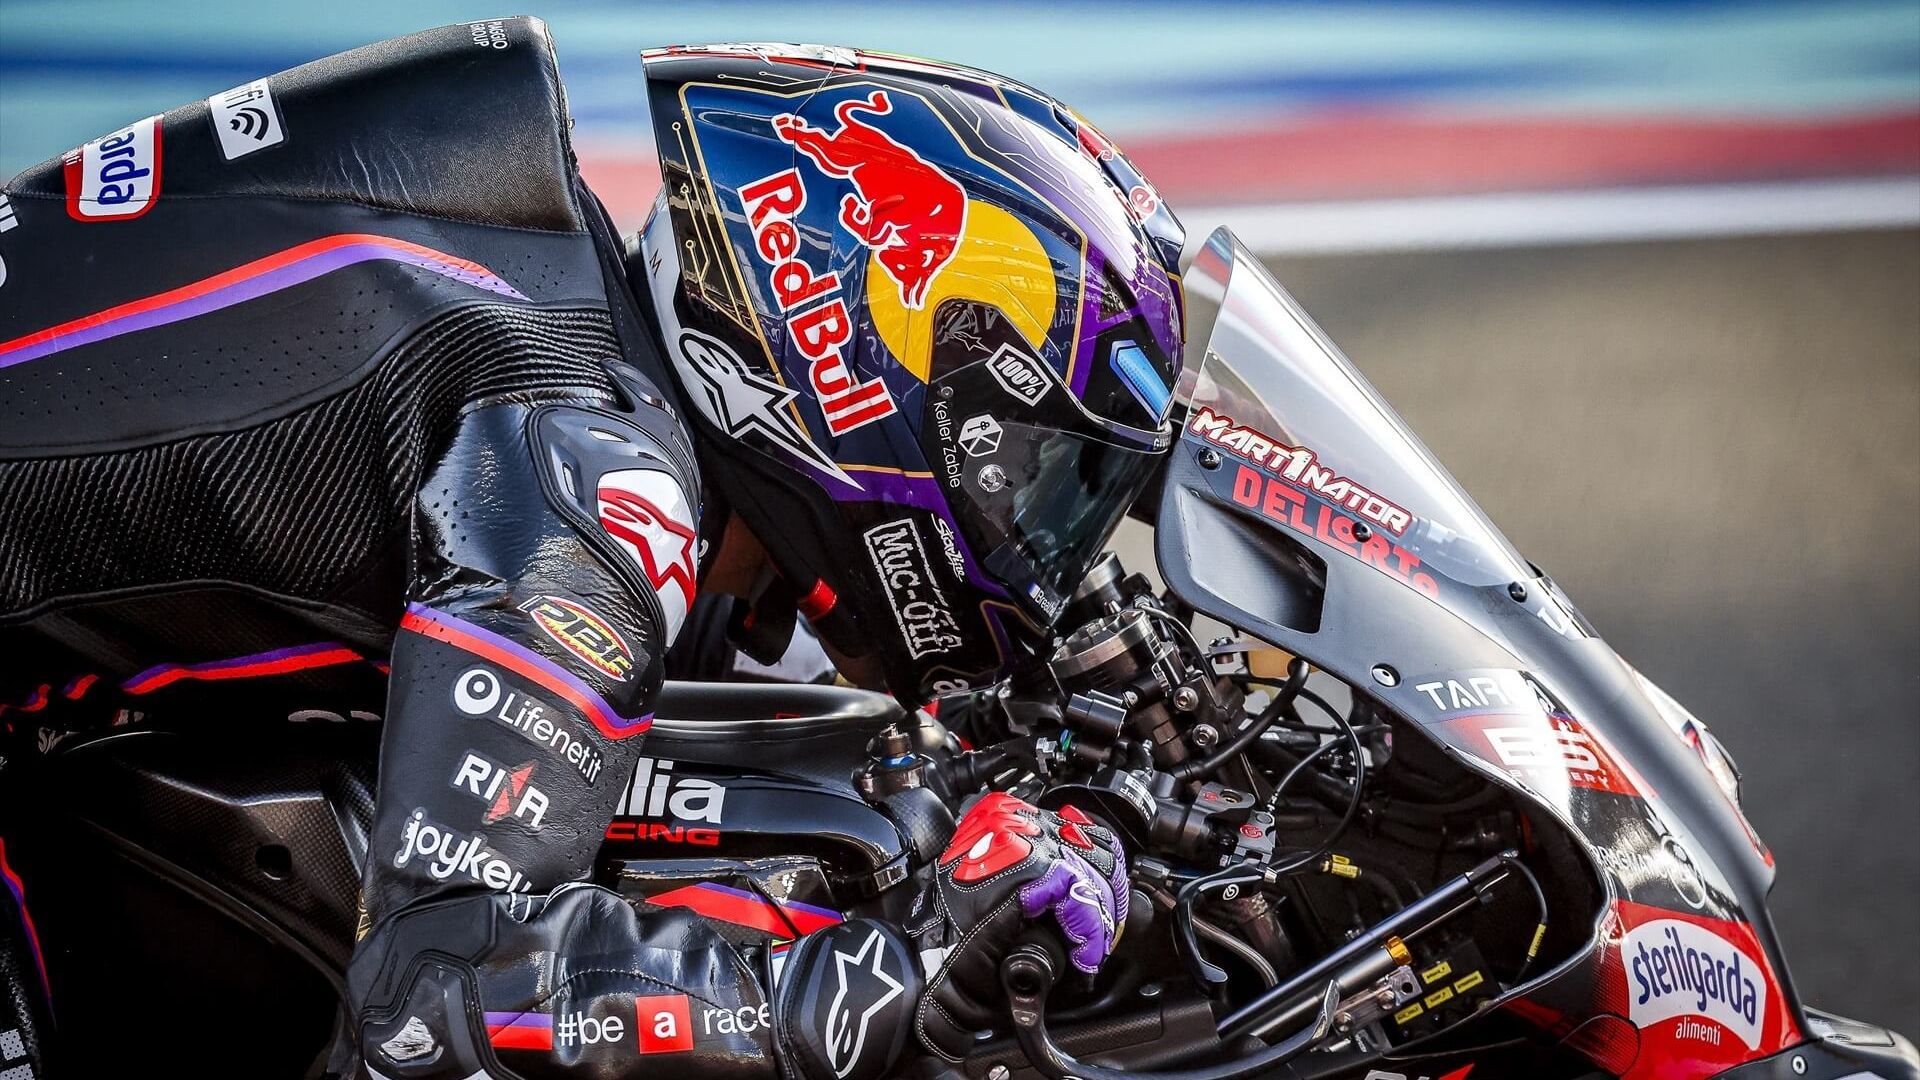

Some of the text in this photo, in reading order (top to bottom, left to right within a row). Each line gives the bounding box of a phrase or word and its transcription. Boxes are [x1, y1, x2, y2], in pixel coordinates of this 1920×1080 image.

[737, 167, 898, 437] Red Bull
[996, 354, 1045, 397] 100%
[933, 401, 962, 489] Keller Zable
[497, 692, 602, 783] Lifenet.it
[1632, 925, 1758, 1027] sterilgarda
[557, 1010, 625, 1047] #be
[653, 1010, 677, 1039] a
[1675, 1016, 1721, 1047] alimenti
